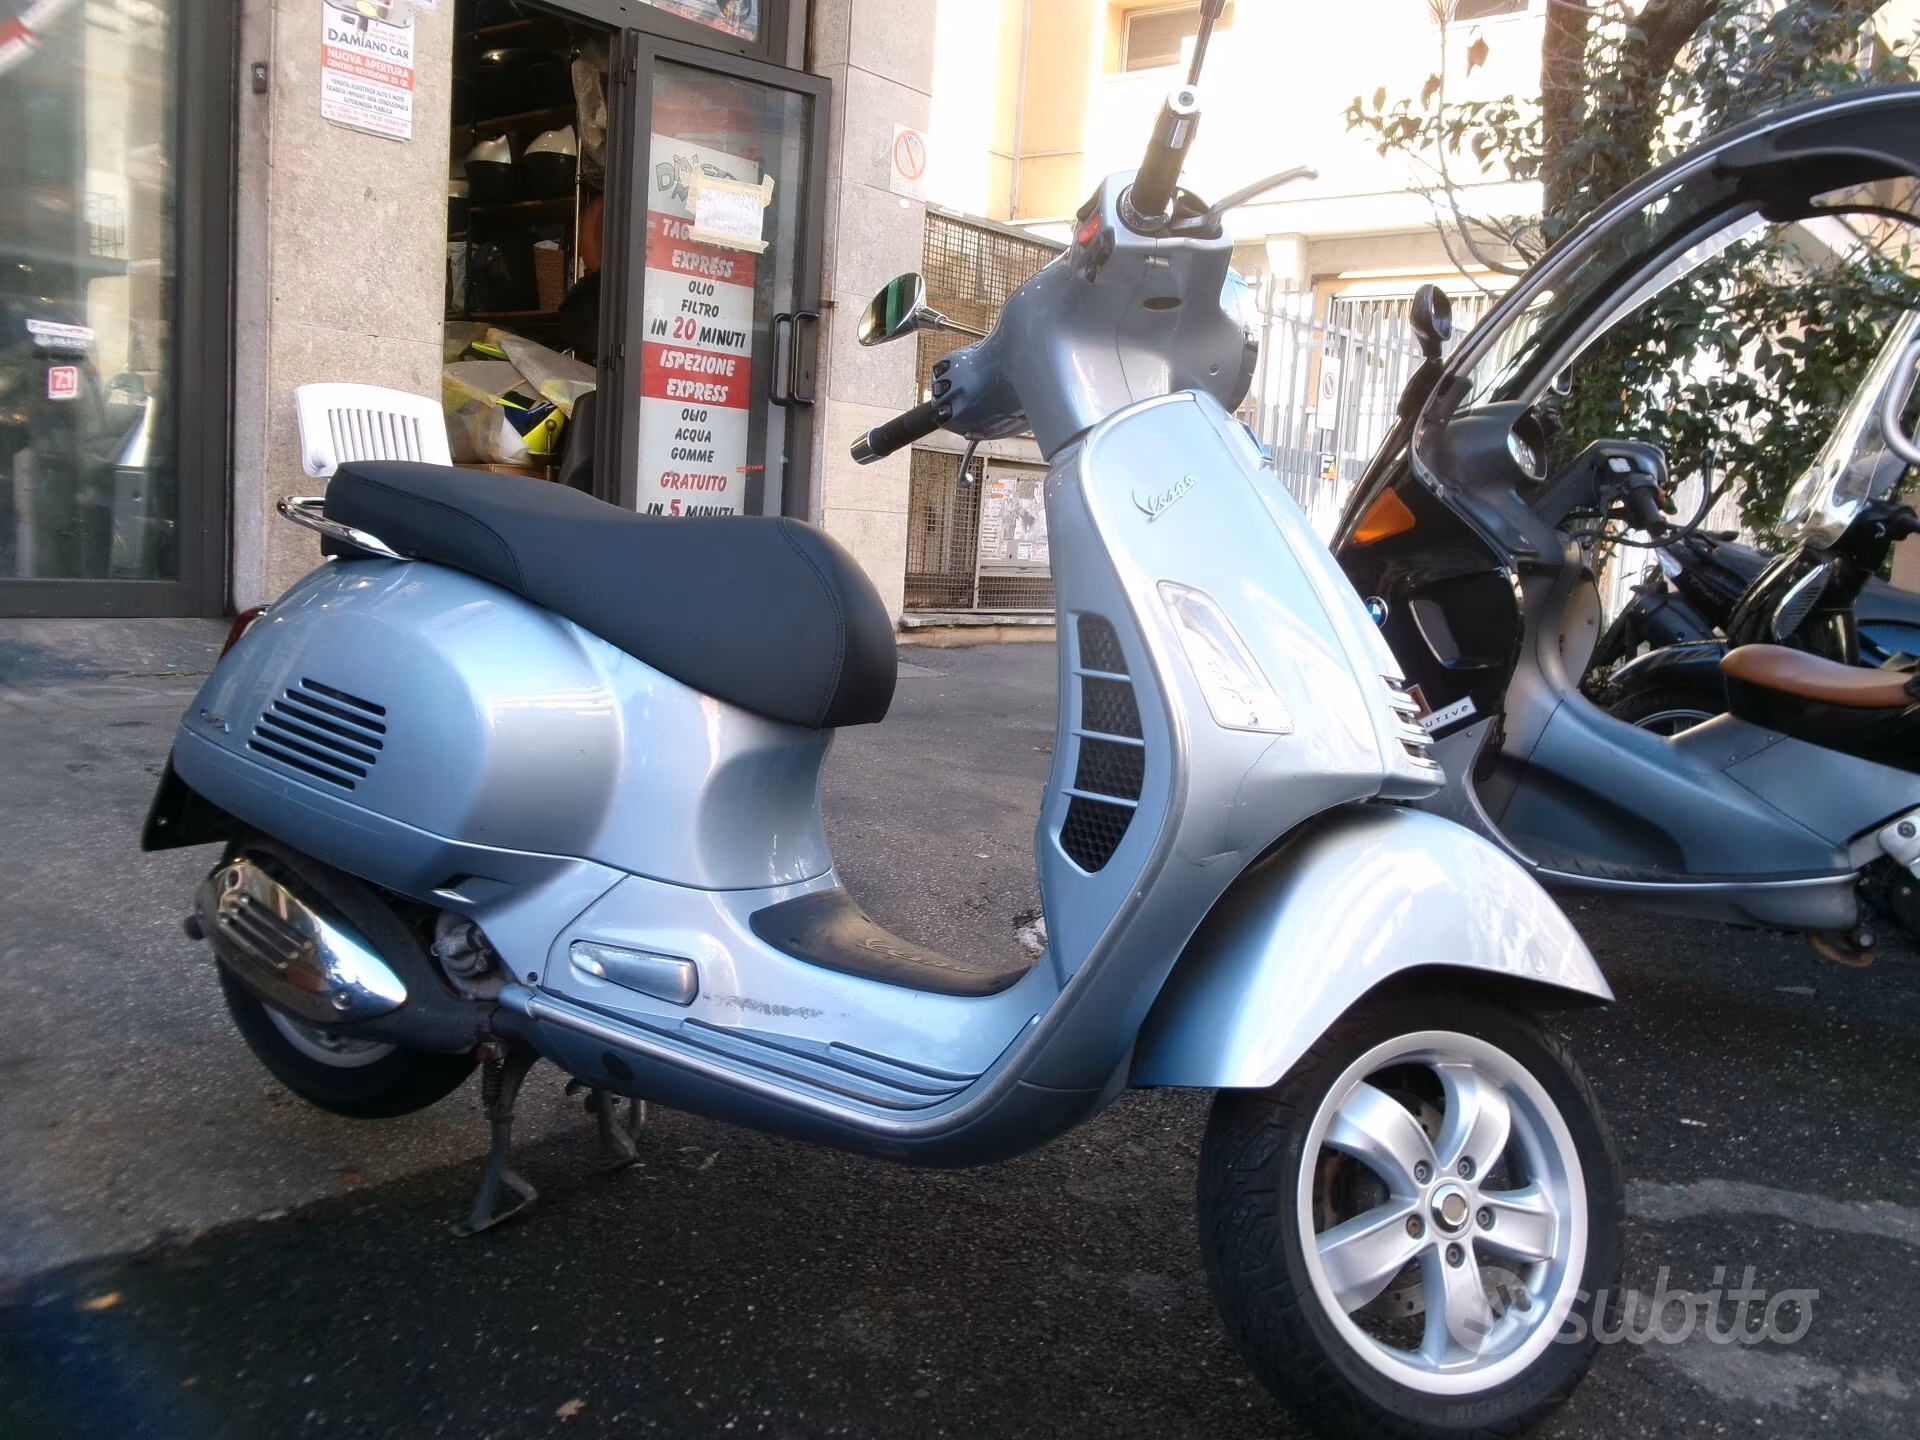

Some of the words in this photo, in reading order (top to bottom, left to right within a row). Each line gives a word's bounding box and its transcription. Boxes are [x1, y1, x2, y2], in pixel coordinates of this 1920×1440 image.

[328, 27, 388, 53] DAMIANO
[389, 45, 409, 59] CAR
[327, 47, 362, 62] NUOVA
[364, 56, 409, 79] APERTURA
[327, 58, 354, 72] CENTRO
[355, 65, 389, 82] REVISIONI
[672, 249, 734, 278] EXPRESS
[688, 280, 715, 297] OLIO
[681, 298, 720, 318] FILTRO
[650, 318, 668, 337] IN
[672, 316, 697, 341] 20
[699, 326, 747, 349] MINUTI
[659, 349, 736, 377] ISPEZIONE
[666, 378, 729, 403] EXPRESS
[681, 407, 708, 423] OLIO
[674, 427, 712, 444] ACQUA
[670, 447, 715, 463] GOMME
[660, 471, 728, 492] GRATUITO
[647, 502, 664, 517] IN
[668, 498, 682, 517] 5
[684, 504, 735, 517] MINUTI
